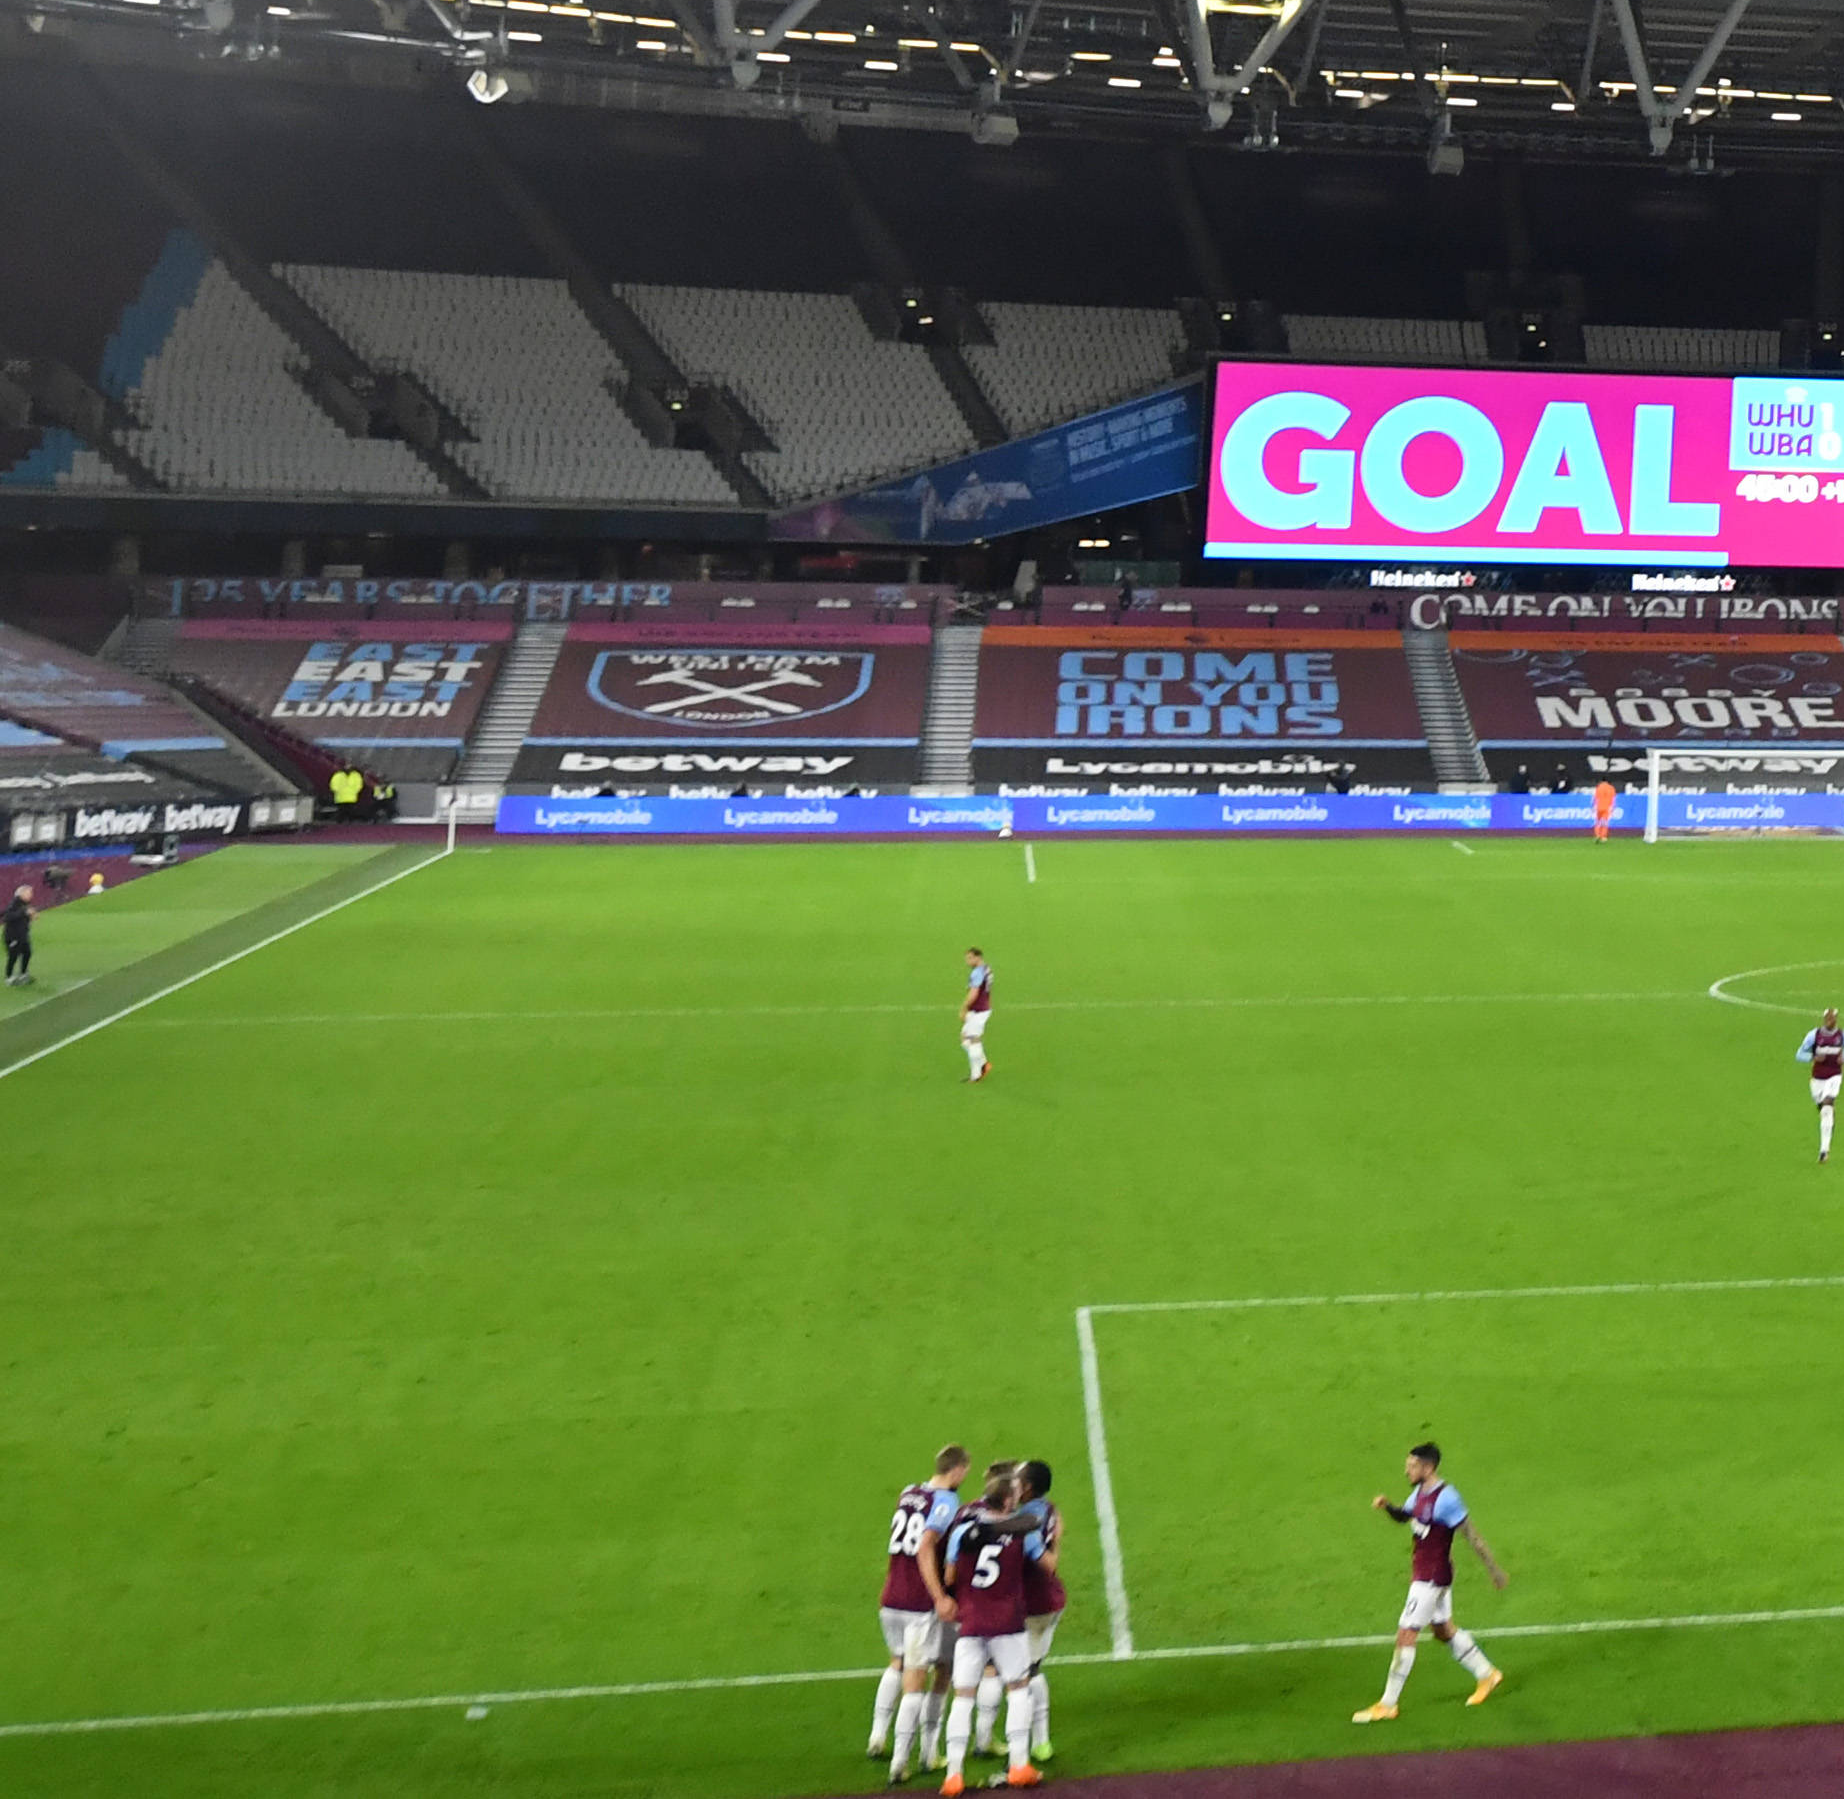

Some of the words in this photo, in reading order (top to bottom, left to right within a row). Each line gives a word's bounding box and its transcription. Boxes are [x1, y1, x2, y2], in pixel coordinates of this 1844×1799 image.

[1748, 403, 1814, 428] WHU
[1820, 403, 1834, 430] 1
[1748, 433, 1813, 457] WBA
[1818, 433, 1841, 461] 0
[1220, 391, 1721, 536] GOAL
[1370, 570, 1463, 589] Heineken
[1631, 572, 1721, 592] Heineken
[259, 579, 405, 603] YEARS
[303, 641, 491, 662] EAST
[291, 661, 482, 682] EAST
[1058, 651, 1339, 682] COME
[279, 681, 472, 702] EAST
[1058, 681, 1163, 706] ON
[1187, 681, 1340, 707] YOU
[270, 701, 452, 718] LONDON
[1054, 705, 1344, 736] IRONS
[559, 752, 855, 776] betway
[1046, 757, 1358, 775] Lycamobile
[1586, 755, 1839, 775] betway
[999, 782, 1088, 796] betway
[1110, 782, 1198, 796] betway
[1219, 782, 1306, 796] betway
[74, 808, 154, 838] betway
[164, 804, 242, 835] betway
[535, 807, 653, 828] Lycamobile
[724, 807, 839, 828] Lycamobile
[1046, 805, 1156, 825] Lycamobile
[1222, 805, 1328, 825] Lycamobile
[1686, 803, 1785, 823] Lycamobile
[888, 1507, 927, 1556] 28
[970, 1544, 1004, 1590] 5
